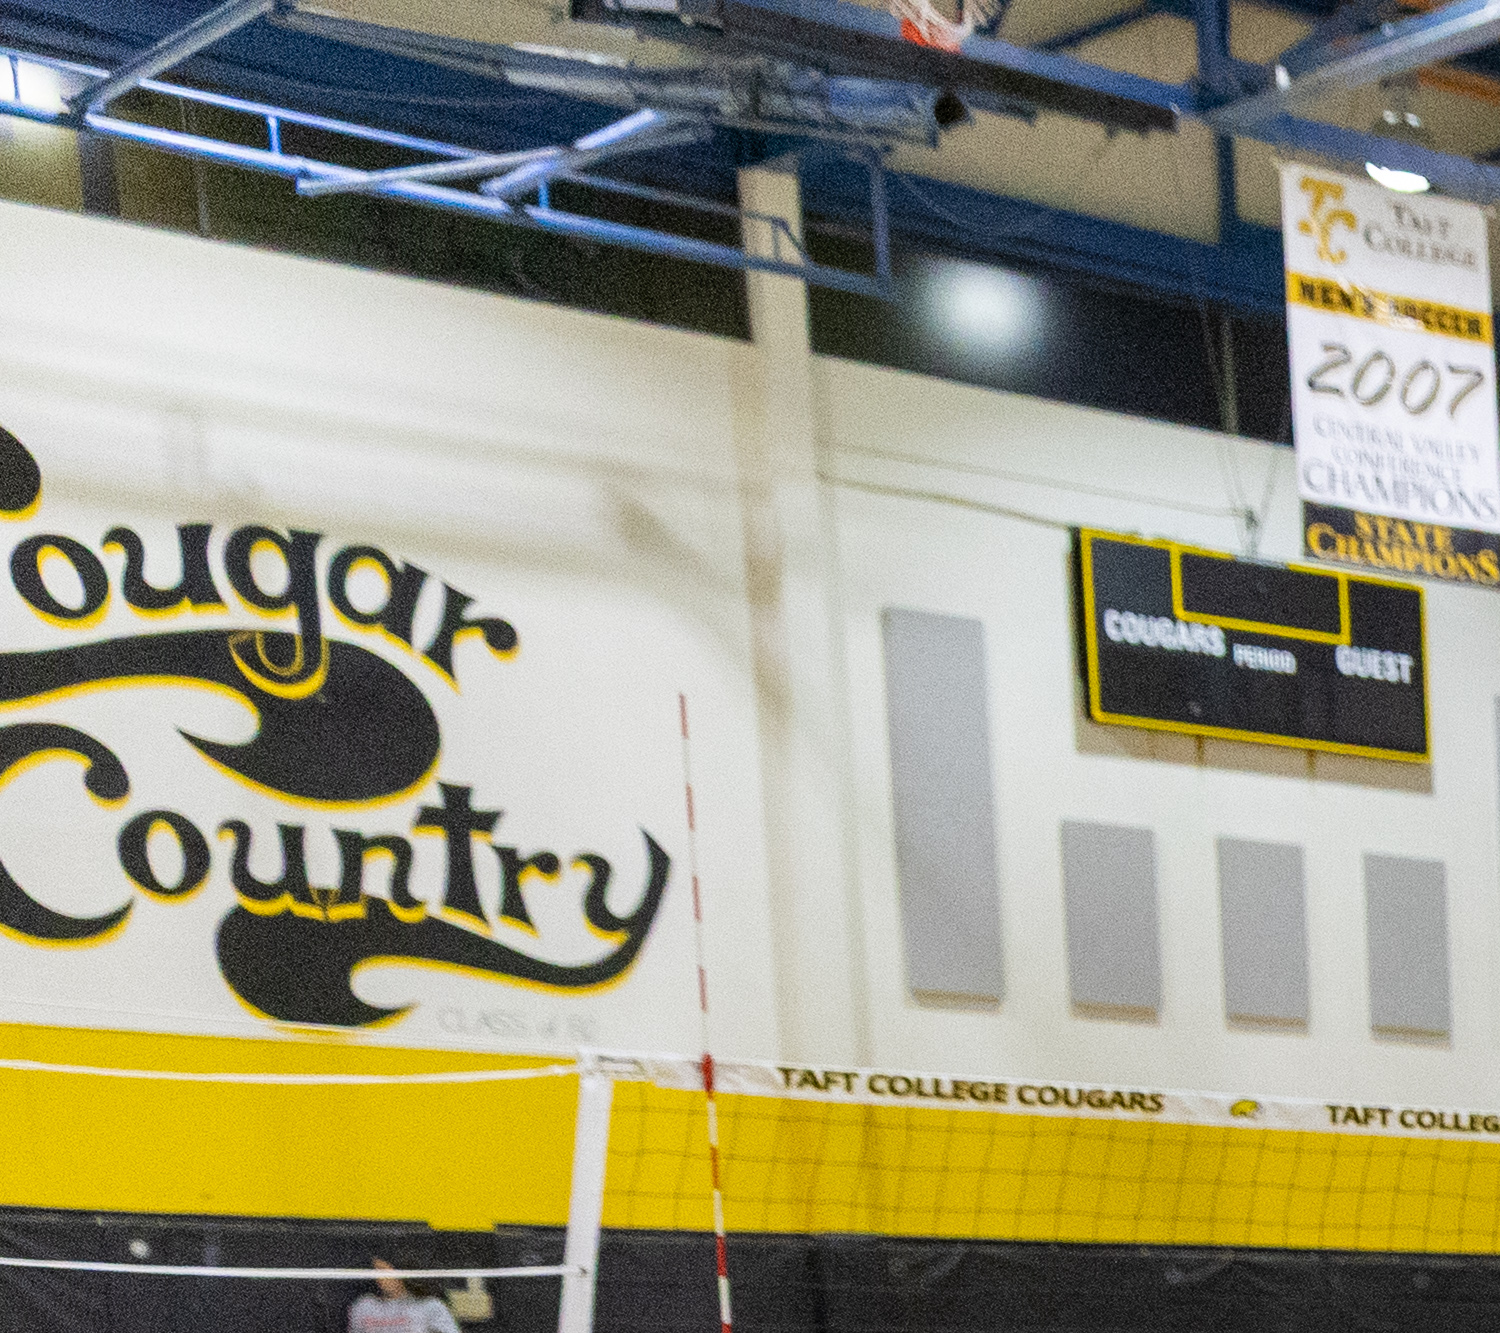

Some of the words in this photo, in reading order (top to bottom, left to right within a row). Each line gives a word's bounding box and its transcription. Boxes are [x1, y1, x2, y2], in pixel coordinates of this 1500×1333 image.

[1307, 343, 1484, 417] 2007
[1303, 458, 1497, 522] CHAMPIONS
[0, 427, 520, 697] ougar
[1104, 608, 1226, 658] COUGARS
[1335, 645, 1414, 684] GUEST
[778, 1067, 858, 1093] TAFT
[867, 1073, 1007, 1104] COLLEGE
[1018, 1085, 1163, 1113] COUGARS
[1326, 1104, 1393, 1129] TAFT
